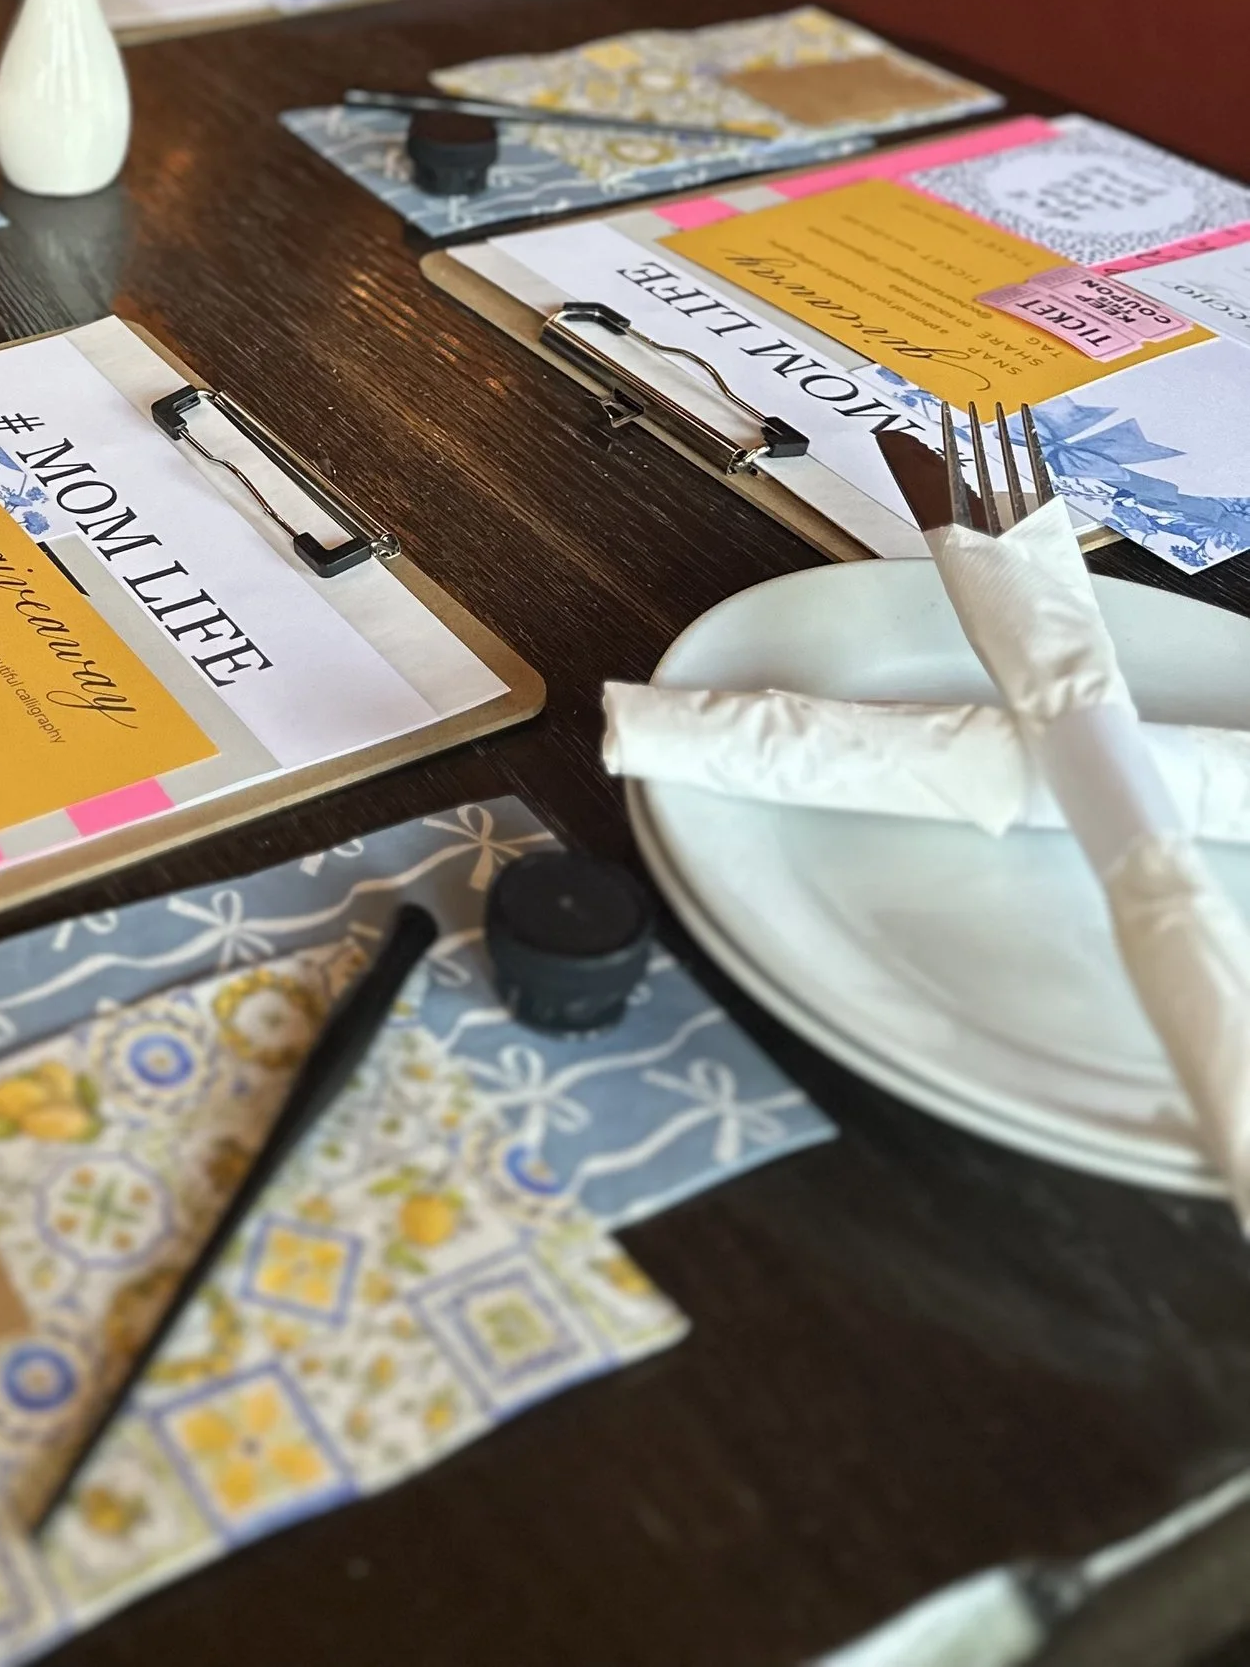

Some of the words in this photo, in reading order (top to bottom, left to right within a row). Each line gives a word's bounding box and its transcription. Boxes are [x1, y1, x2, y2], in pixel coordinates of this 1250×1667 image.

[920, 254, 982, 284] TICKET
[616, 261, 762, 337] LIFE
[719, 248, 990, 391] giveaway
[1015, 298, 1112, 347] TICKET
[1074, 294, 1137, 323] KEEP
[1081, 279, 1171, 324] COUPON
[967, 347, 1022, 376] SNAP
[977, 331, 1044, 367] SHARE
[1025, 336, 1062, 359] TAG
[739, 339, 927, 434] MOM
[122, 559, 274, 687] LIFE
[15, 688, 66, 744] calligraphy
